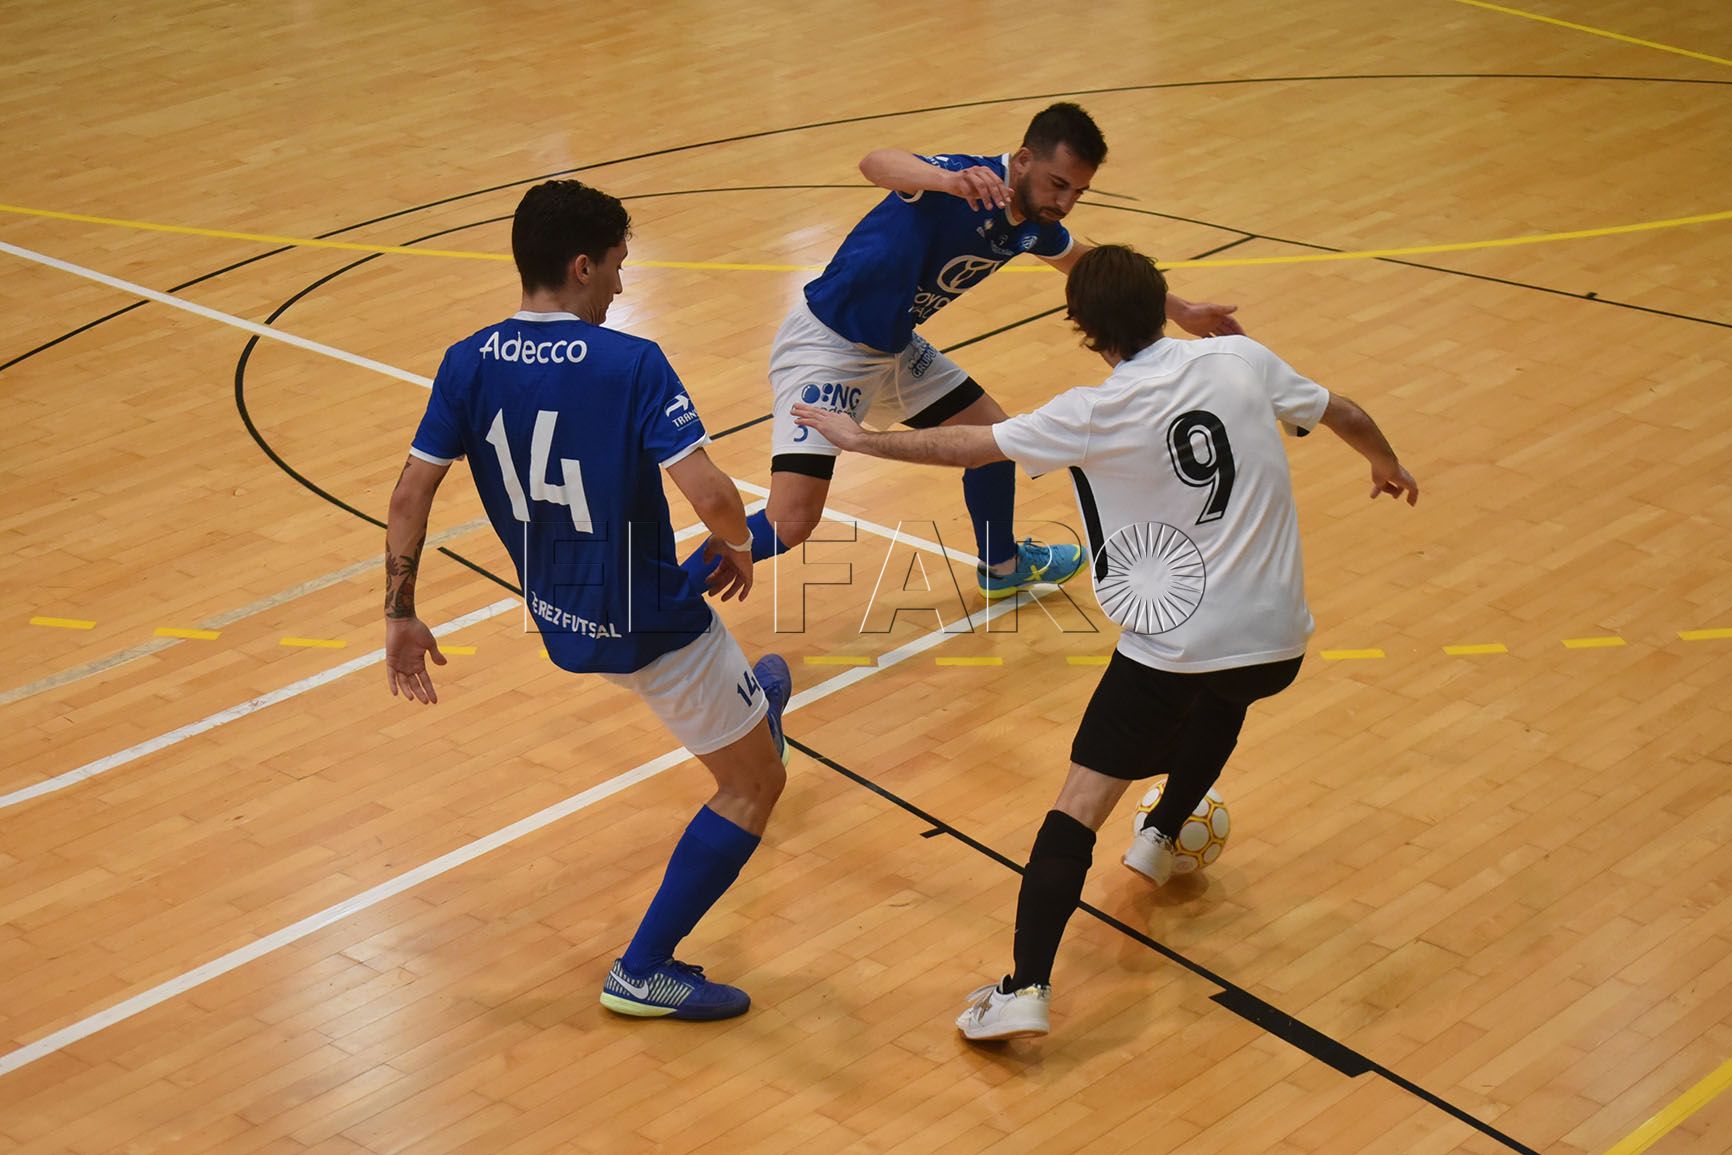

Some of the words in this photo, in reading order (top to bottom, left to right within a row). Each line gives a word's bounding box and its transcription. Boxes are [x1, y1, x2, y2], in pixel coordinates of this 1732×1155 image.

[479, 330, 588, 365] Adecco
[485, 407, 594, 534] 14
[1166, 409, 1236, 526] 9
[562, 612, 623, 640] FUTSAL
[737, 670, 761, 708] 14
